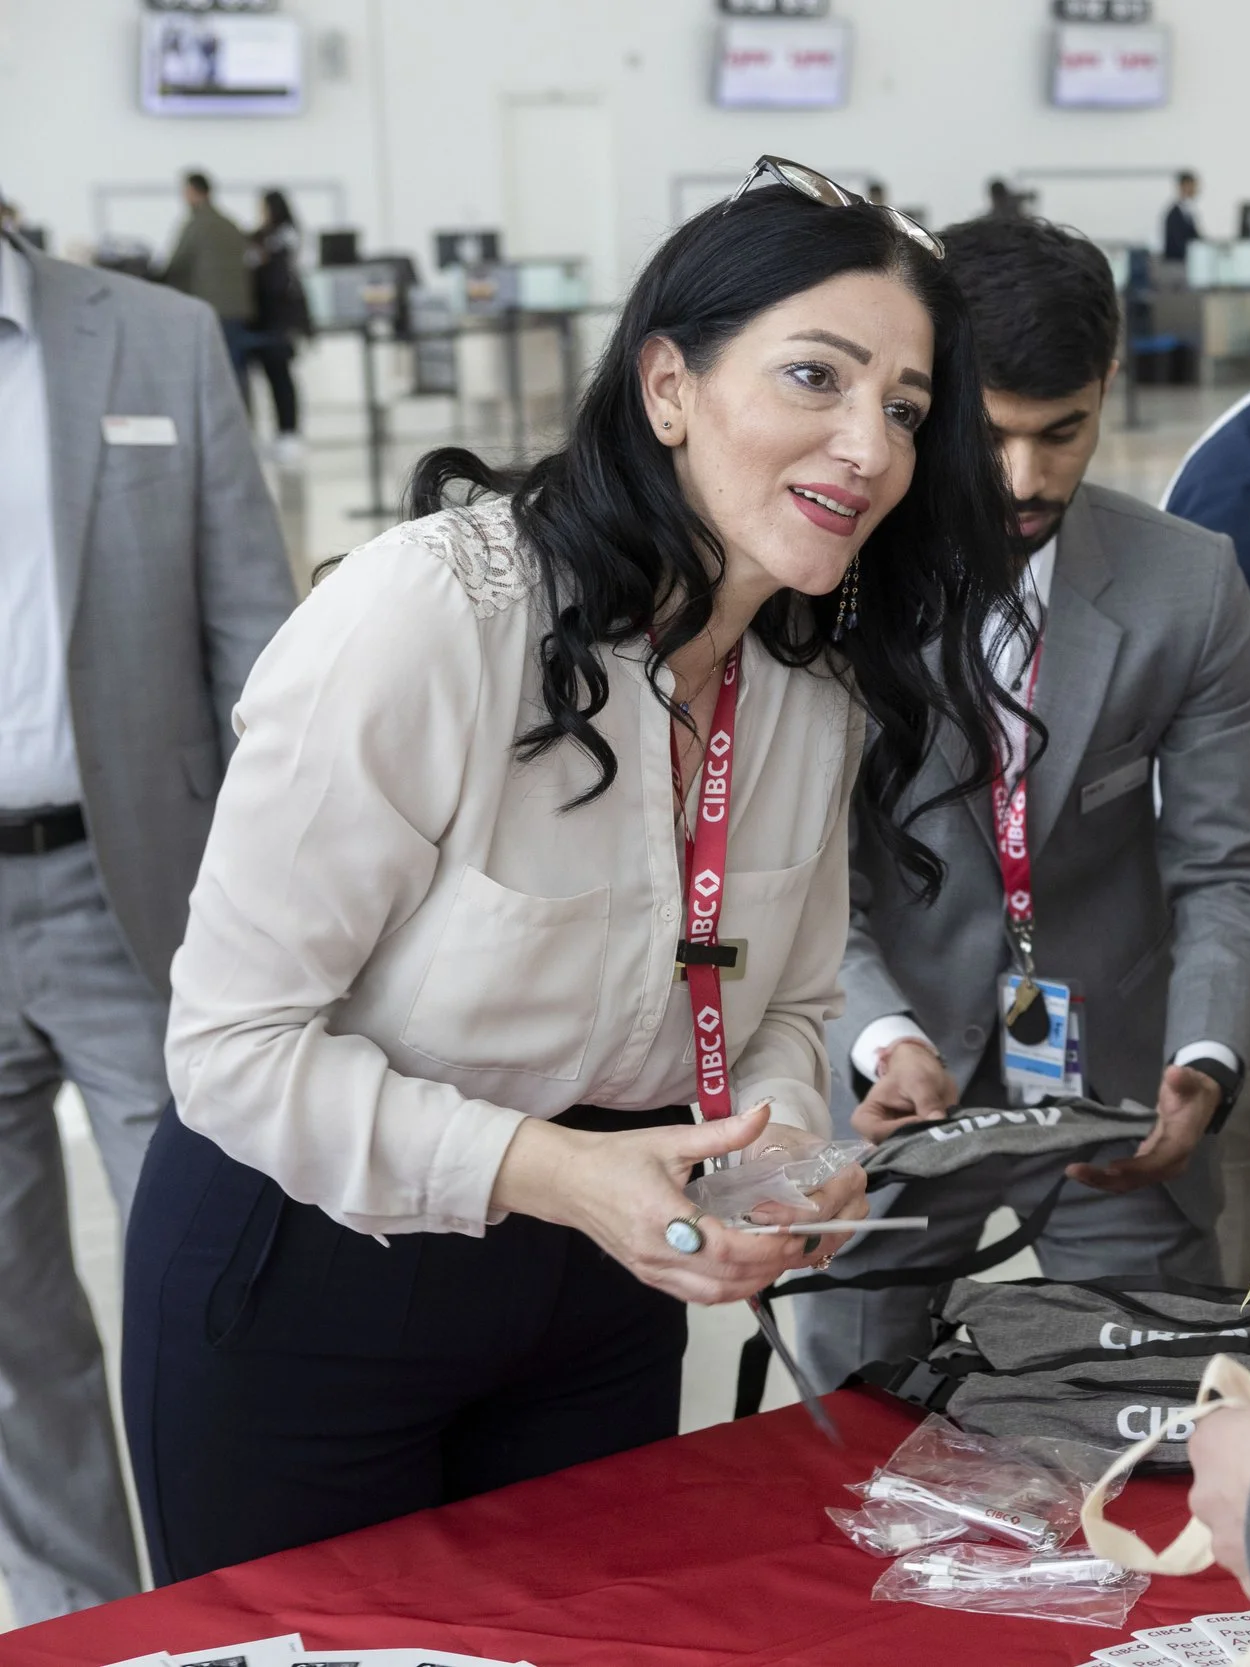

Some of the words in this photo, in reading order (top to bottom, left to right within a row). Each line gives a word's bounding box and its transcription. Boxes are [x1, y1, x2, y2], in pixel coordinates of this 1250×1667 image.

[702, 759, 729, 823] CIBC
[1008, 813, 1027, 859] CIBC
[690, 900, 718, 945] IBC
[700, 1034, 726, 1096] CIBC
[1117, 1405, 1196, 1440] CIB
[985, 1509, 1011, 1522] CIBC
[1147, 1628, 1180, 1638] CIBC
[1206, 1615, 1240, 1624] CIBC
[1108, 1646, 1140, 1657] CIBC
